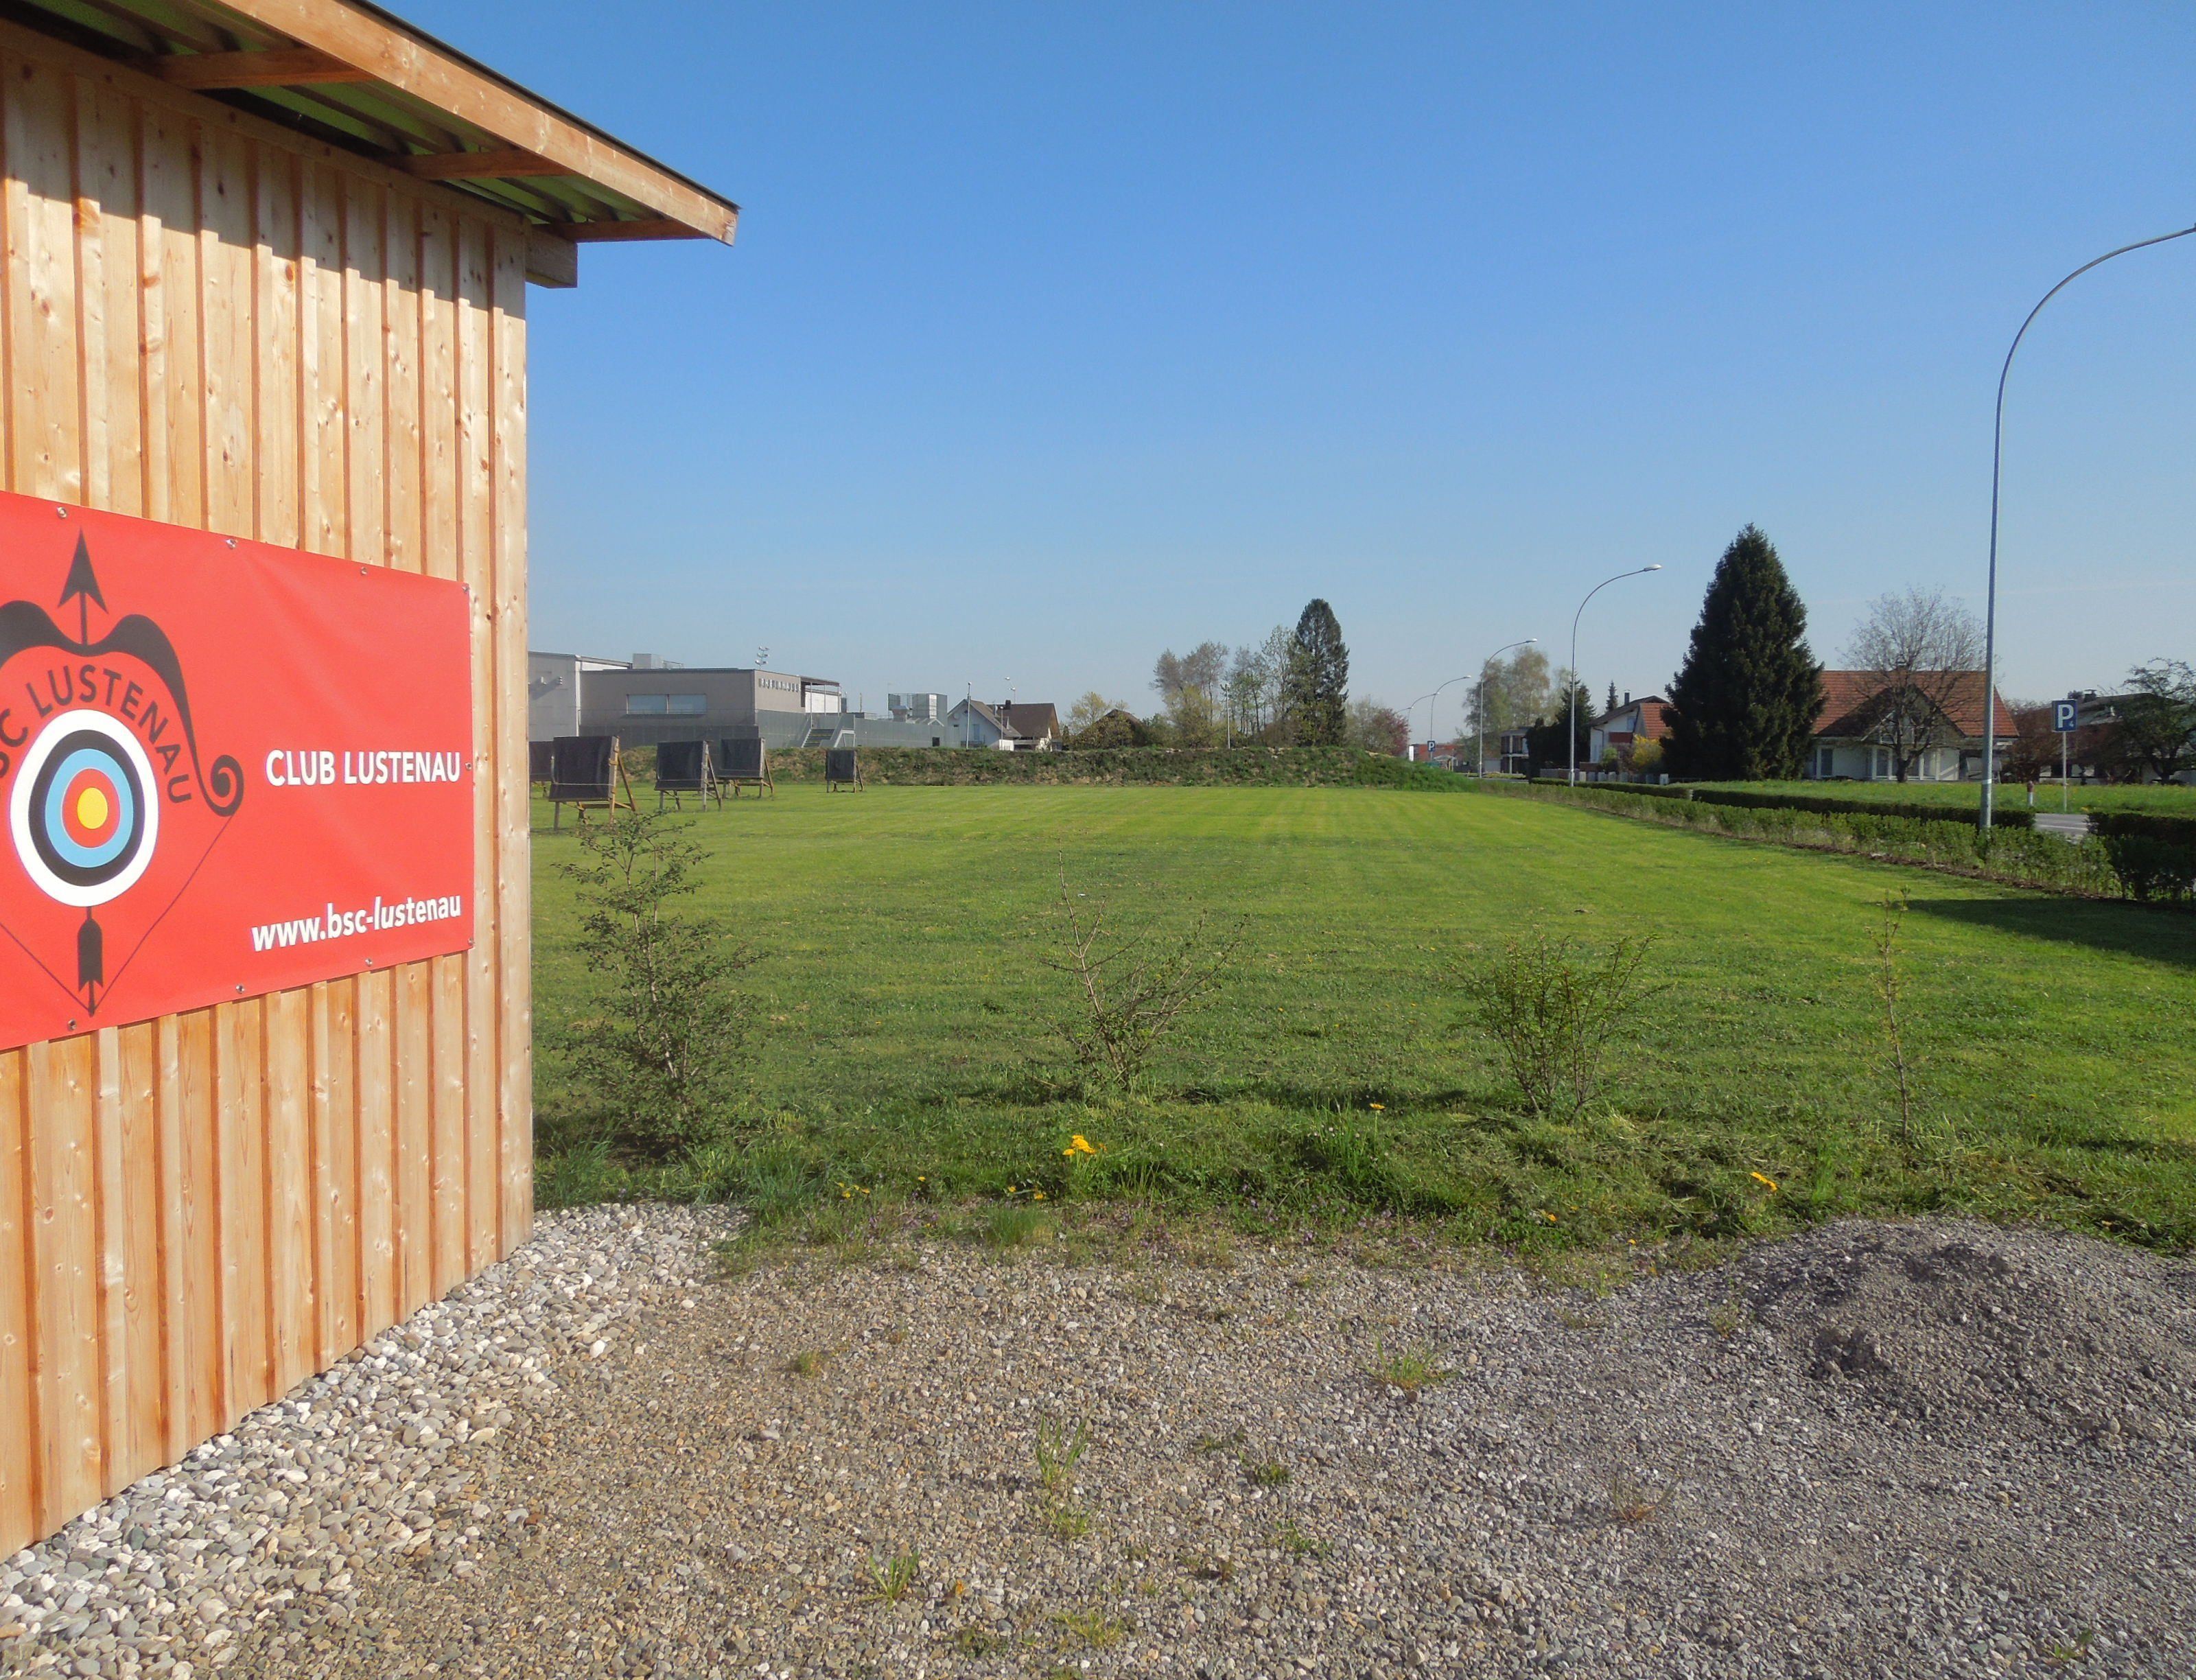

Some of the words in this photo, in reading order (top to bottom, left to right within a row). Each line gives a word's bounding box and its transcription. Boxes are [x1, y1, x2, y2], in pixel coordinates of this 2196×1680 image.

[25, 664, 192, 804] LUSTENAU
[2058, 704, 2074, 728] P
[266, 749, 336, 786] CLUB
[344, 751, 460, 784] LUSTENAU
[251, 895, 461, 952] www.bsc-lustenau
